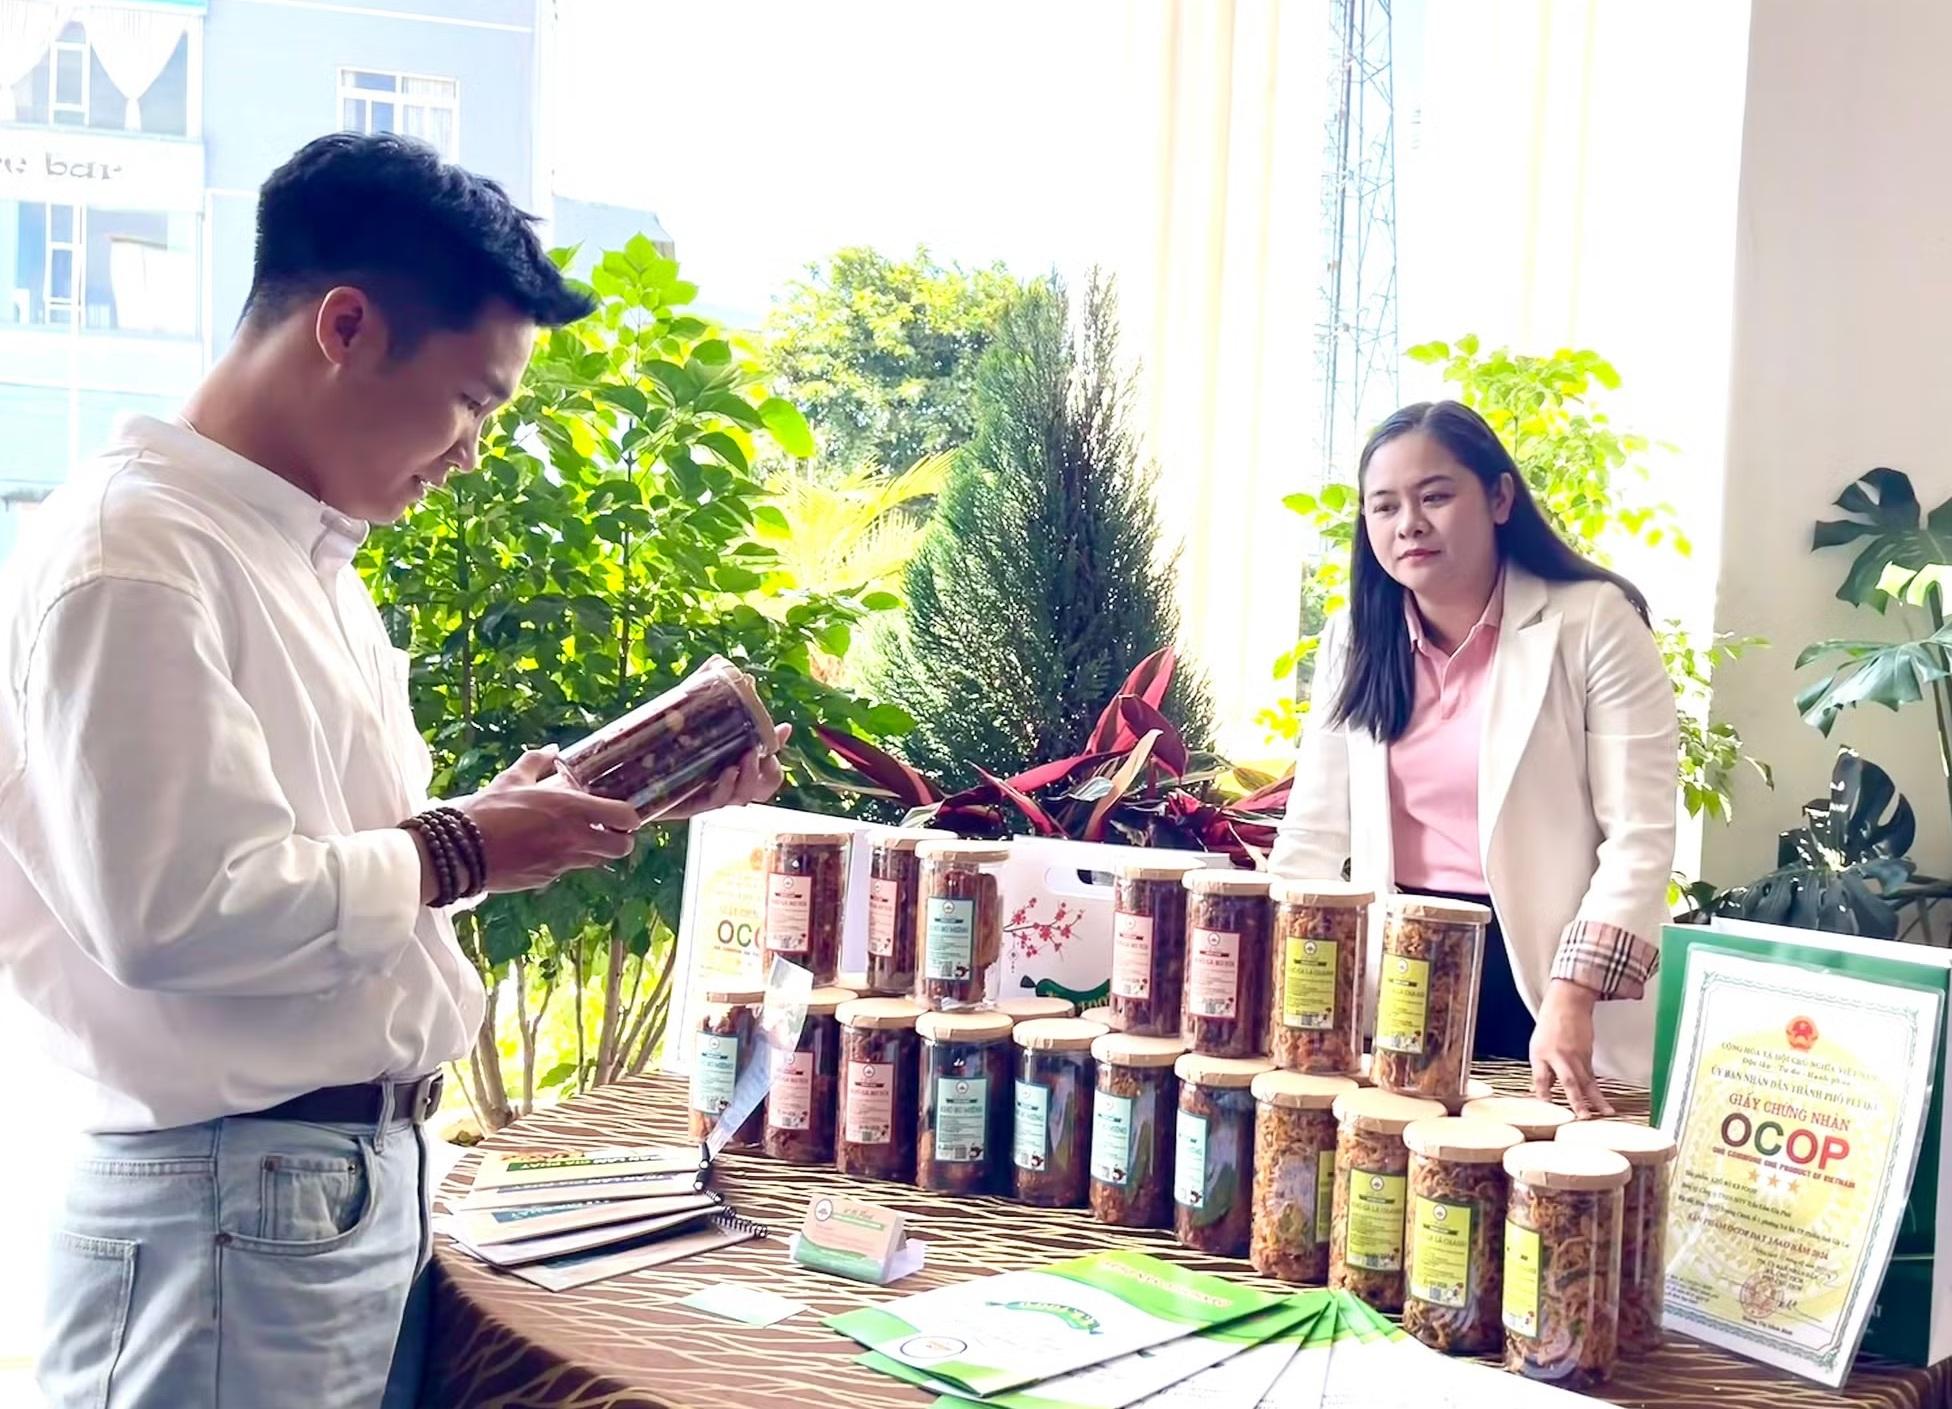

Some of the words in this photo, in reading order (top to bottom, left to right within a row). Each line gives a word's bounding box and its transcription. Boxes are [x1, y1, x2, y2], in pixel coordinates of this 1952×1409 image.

[45, 151, 123, 180] bar
[1727, 1088, 1762, 1111] GIẤY
[1761, 1097, 1809, 1123] CHỨNG
[1720, 1112, 1850, 1170] OCOP
[1778, 1162, 1811, 1178] PRODUCT
